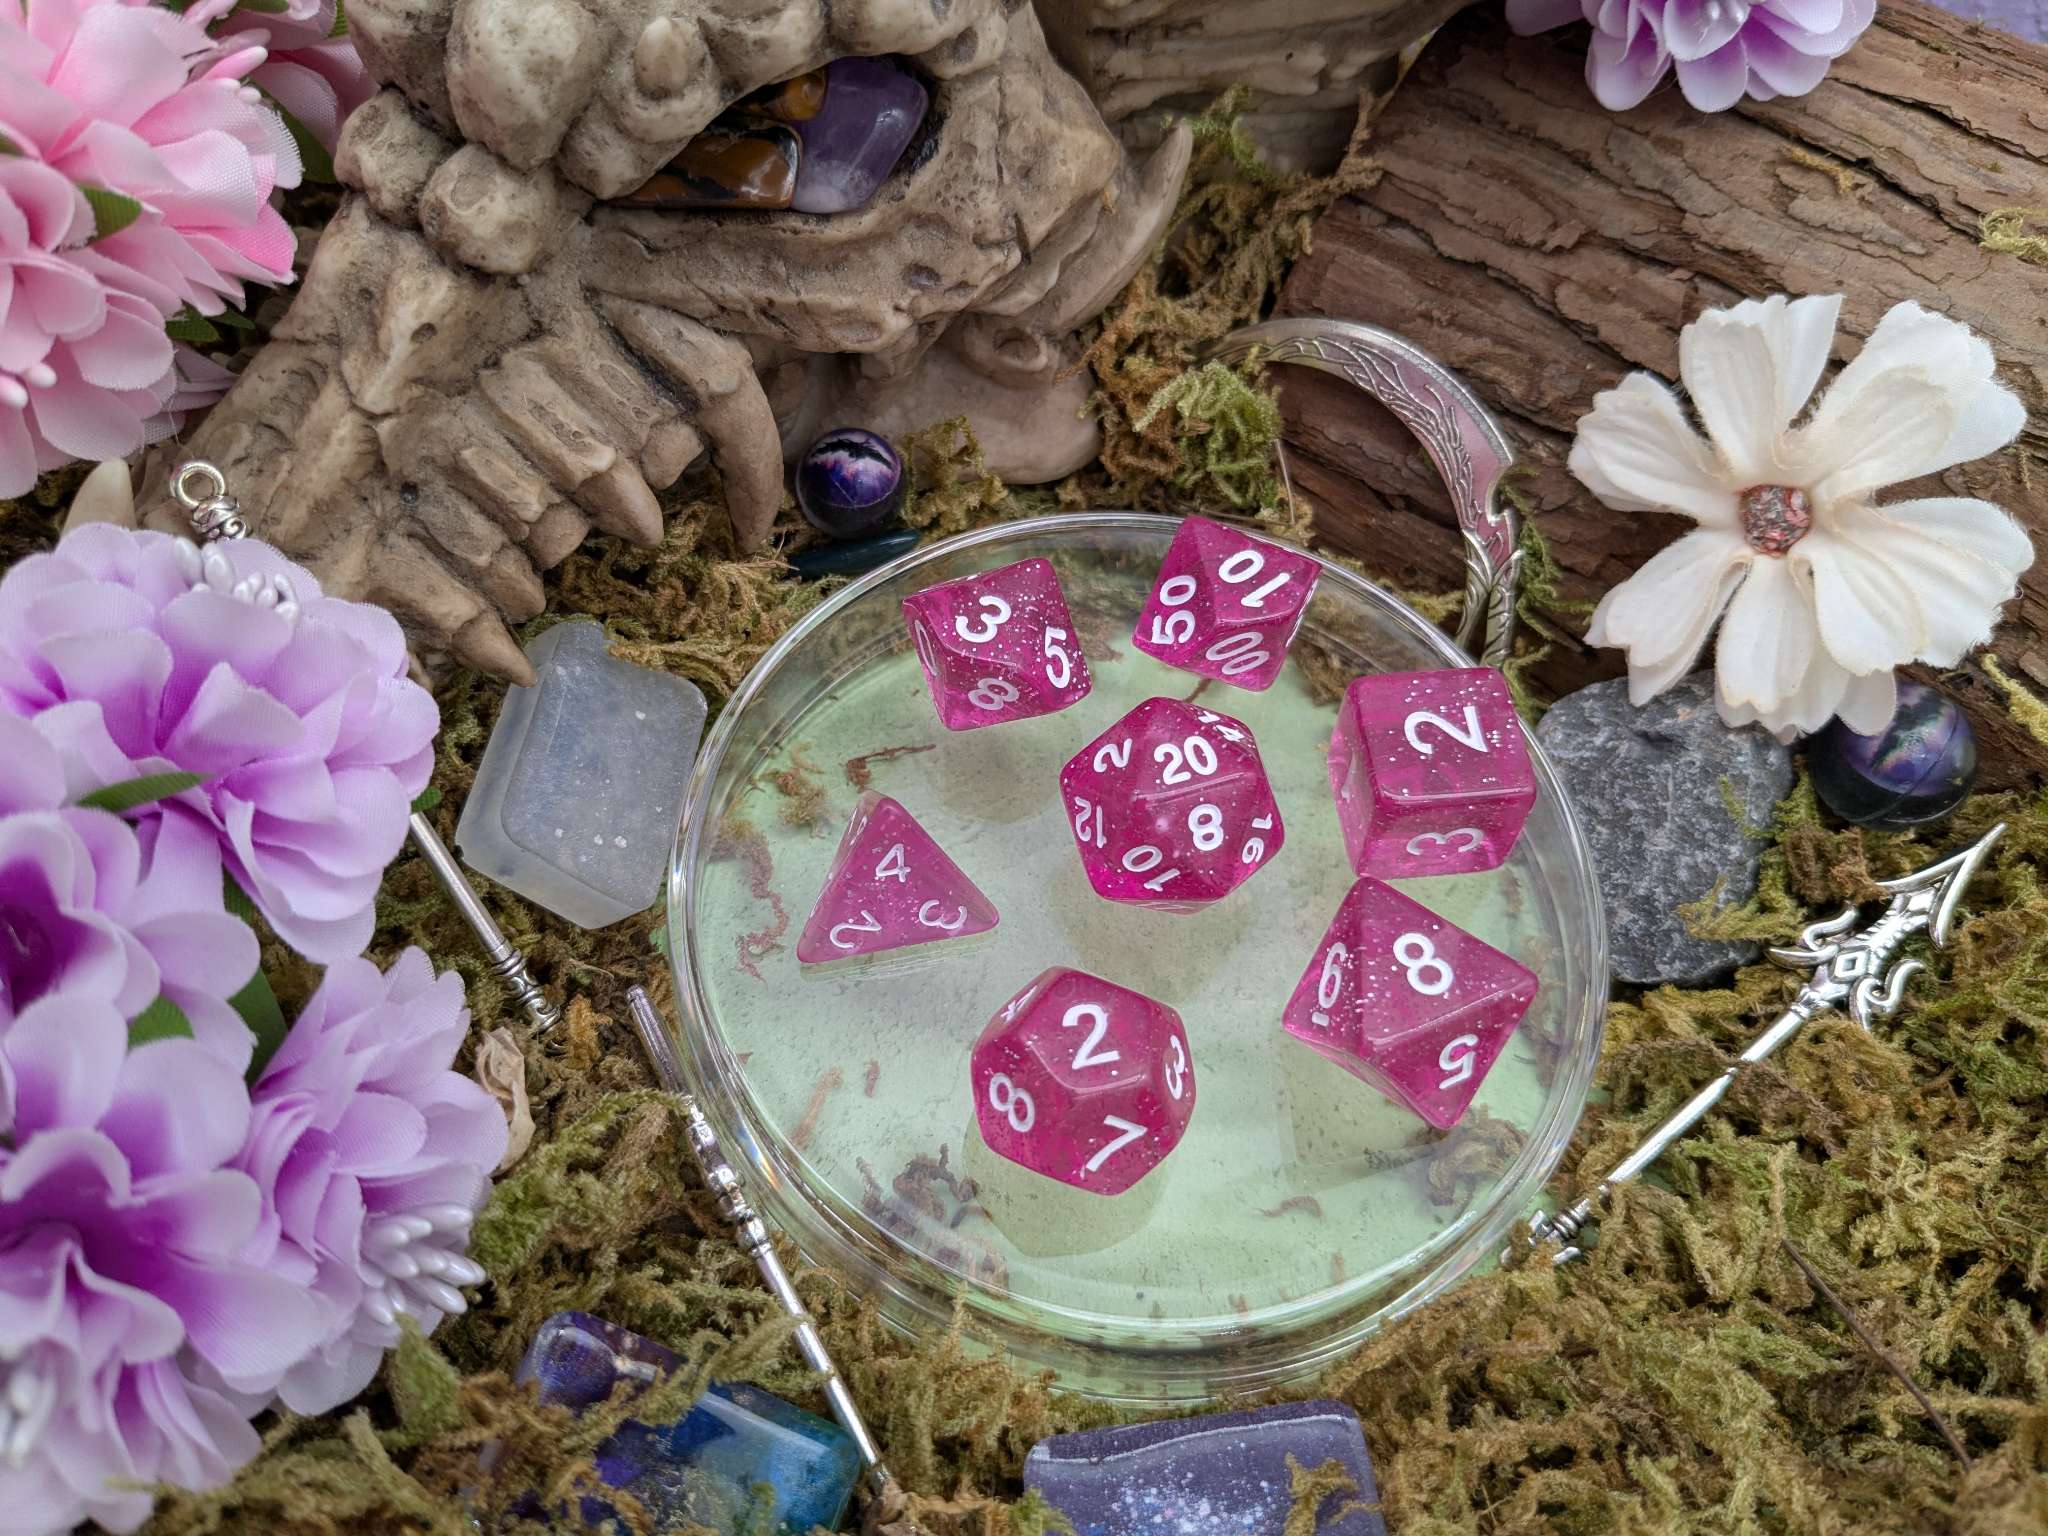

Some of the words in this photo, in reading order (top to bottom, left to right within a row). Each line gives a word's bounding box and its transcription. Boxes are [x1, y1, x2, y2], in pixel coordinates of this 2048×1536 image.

[1218, 550, 1290, 608] 10
[956, 595, 1011, 643] 3
[1151, 575, 1197, 645] 50
[1044, 626, 1071, 689] 5
[1205, 631, 1270, 676] 00
[968, 678, 1020, 711] 8
[1404, 706, 1488, 755] 2
[1093, 738, 1133, 773] 2
[1154, 735, 1218, 785] 20
[1074, 796, 1107, 849] 12
[1188, 803, 1224, 851] 8
[1406, 827, 1485, 856] 3
[876, 843, 912, 883] 4
[1122, 845, 1181, 892] 10
[830, 910, 882, 948] 2
[919, 900, 968, 930] 3
[1393, 932, 1454, 996] 8
[1062, 1003, 1120, 1070] 2
[1165, 1035, 1185, 1100] 3
[1439, 1034, 1479, 1089] 5
[989, 1072, 1035, 1132] 8
[1086, 1115, 1148, 1172] 7
